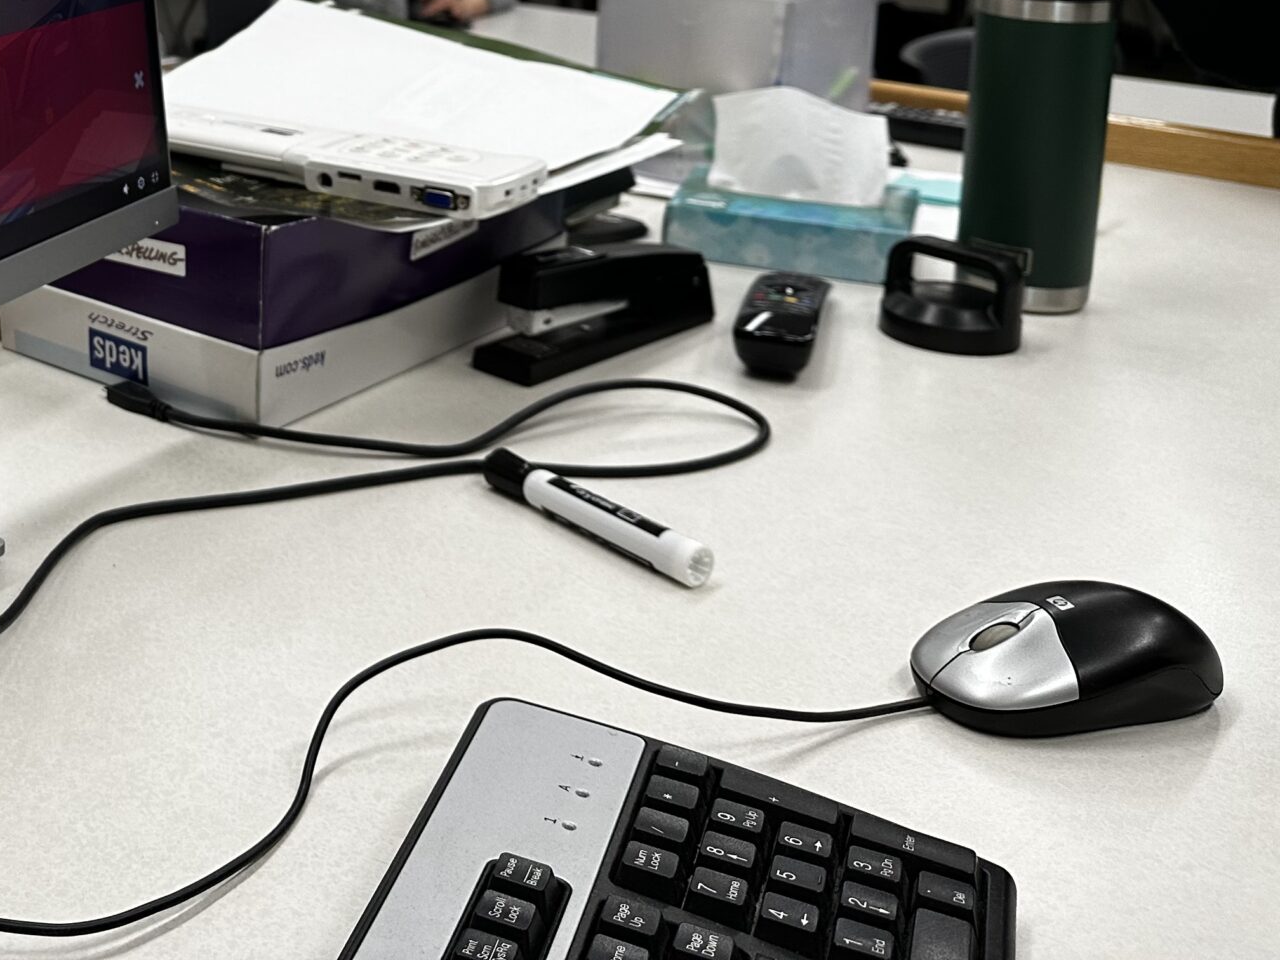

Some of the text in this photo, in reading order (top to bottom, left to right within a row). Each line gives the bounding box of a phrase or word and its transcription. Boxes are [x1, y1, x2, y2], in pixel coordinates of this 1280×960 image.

[88, 313, 154, 341] Stretch
[93, 335, 143, 379] keds
[275, 350, 326, 378] keds.com
[716, 812, 736, 822] 9
[742, 810, 759, 828] Pg Up
[783, 834, 803, 846] 6
[634, 849, 648, 867] Num
[705, 844, 725, 856] 8
[500, 857, 518, 878] Pause
[648, 850, 663, 871] Lock
[853, 859, 872, 871] 3
[880, 857, 894, 878] Pg Dn
[526, 867, 544, 887] Break
[775, 869, 797, 881] 5
[697, 882, 717, 894] 7
[726, 880, 741, 901] Home
[848, 896, 868, 909] 2
[952, 891, 966, 905] Del
[488, 897, 505, 918] Scroll
[504, 905, 522, 924] Lock
[613, 902, 630, 923] Page
[767, 908, 788, 920] 4
[629, 916, 646, 928] Up
[461, 939, 479, 956] Print
[686, 932, 704, 952] Page
[701, 934, 720, 958] Down
[843, 936, 863, 947] 1
[871, 937, 886, 954] End
